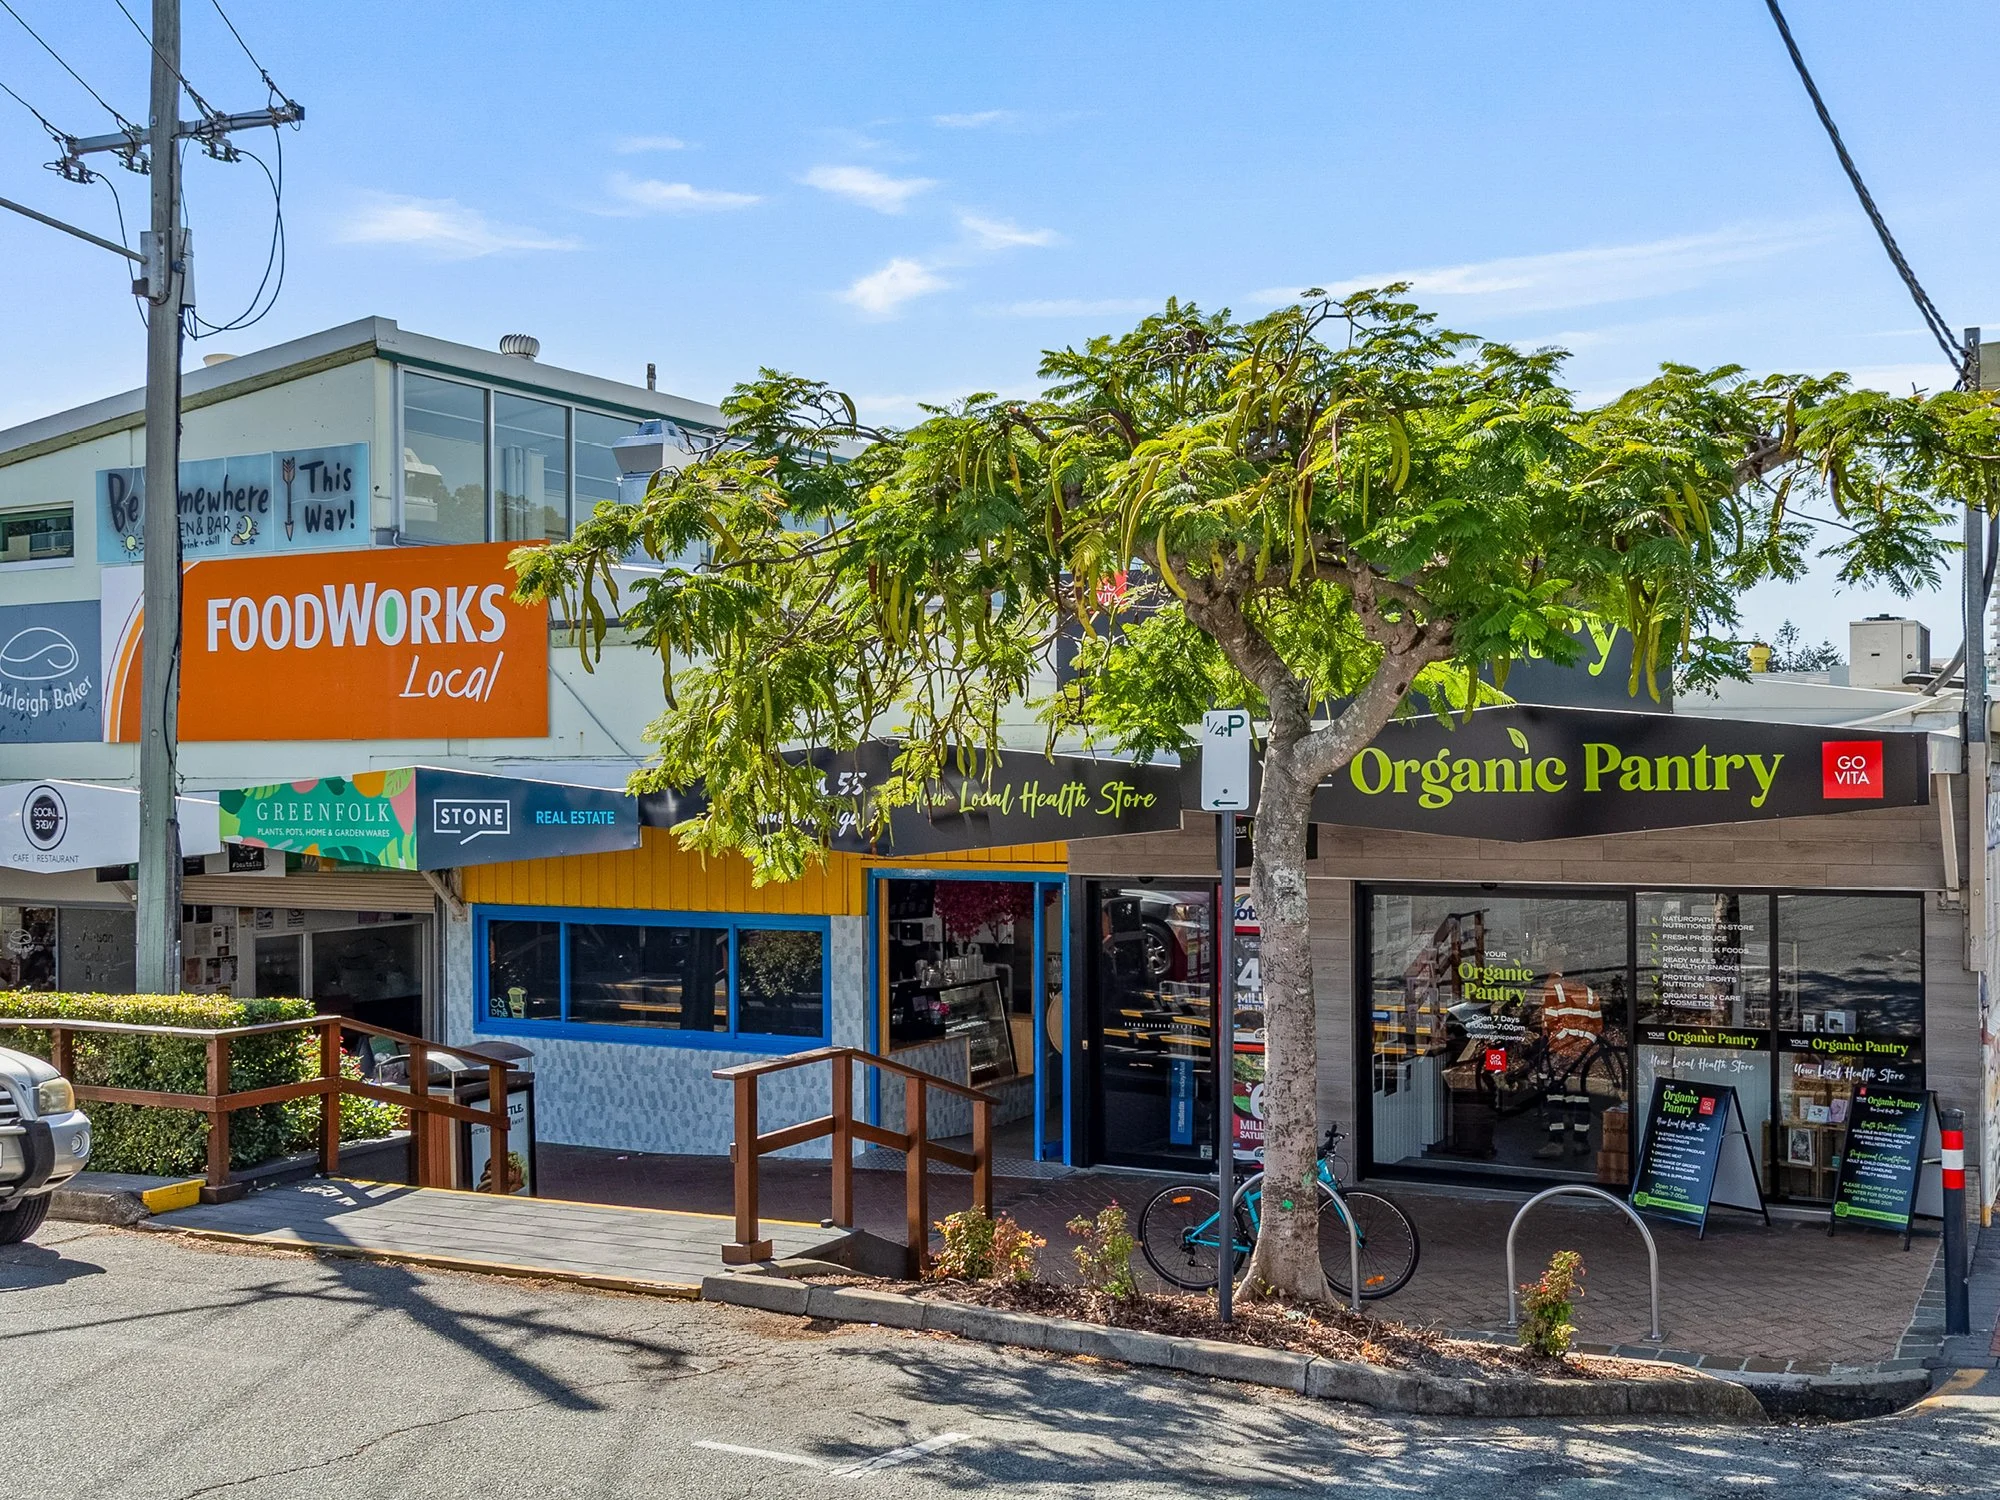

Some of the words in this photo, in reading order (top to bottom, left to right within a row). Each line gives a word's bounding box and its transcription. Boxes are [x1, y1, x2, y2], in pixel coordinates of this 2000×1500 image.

[299, 461, 352, 493] This
[108, 473, 139, 533] Be
[179, 474, 270, 514] mewhere
[207, 515, 231, 535] BAR
[304, 500, 355, 533] Way!
[183, 538, 199, 550] rink
[205, 534, 220, 547] chill
[207, 582, 506, 652] FOODWORKS
[399, 650, 504, 703] Local
[0, 682, 48, 717] urleigh
[53, 676, 92, 709] Baker
[1350, 728, 1567, 809] Organic
[1583, 743, 1785, 807] Pantry
[1837, 755, 1867, 771] GO
[1834, 770, 1871, 786] VITA
[959, 781, 1014, 817] Local
[1019, 780, 1091, 818] Health
[1095, 781, 1157, 818] Store
[33, 807, 57, 817] SOCIAL
[256, 802, 390, 822] GREENFOLK
[441, 808, 503, 825] STONE
[536, 811, 567, 824] REAL
[570, 811, 615, 825] ESTATE
[306, 828, 326, 837] HOME
[328, 829, 333, 837] &
[335, 829, 365, 837] GARDEN
[365, 829, 390, 838] WARES
[1236, 826, 1247, 835] OUR
[13, 853, 30, 863] CAFE
[36, 854, 79, 863] RESTAURANT
[1484, 950, 1507, 958] YOUR
[1458, 959, 1534, 985] Organic
[1237, 993, 1264, 1004] MILL
[1464, 982, 1527, 1007] Pantry
[1472, 1014, 1492, 1023] Open
[1501, 1015, 1520, 1023] Days
[1668, 1029, 1715, 1045] Organic
[1718, 1033, 1759, 1049] Pantry
[1812, 1036, 1862, 1053] Organic
[1865, 1041, 1909, 1057] Pantry
[1650, 1055, 1669, 1067] Your
[1672, 1056, 1695, 1070] Local
[1698, 1058, 1727, 1072] Health
[1729, 1059, 1755, 1073] Store
[1794, 1064, 1815, 1076] Your
[1818, 1065, 1841, 1079] Local
[1844, 1065, 1876, 1081] Health
[1878, 1068, 1905, 1083] Store
[1663, 1089, 1699, 1104] Organic
[1867, 1096, 1896, 1107] Organic
[1897, 1099, 1922, 1111] Pantry
[1663, 1101, 1694, 1118] Pantry
[1240, 1120, 1264, 1131] MILL
[1655, 1182, 1668, 1190] Open
[1843, 1188, 1867, 1196] COUNTER
